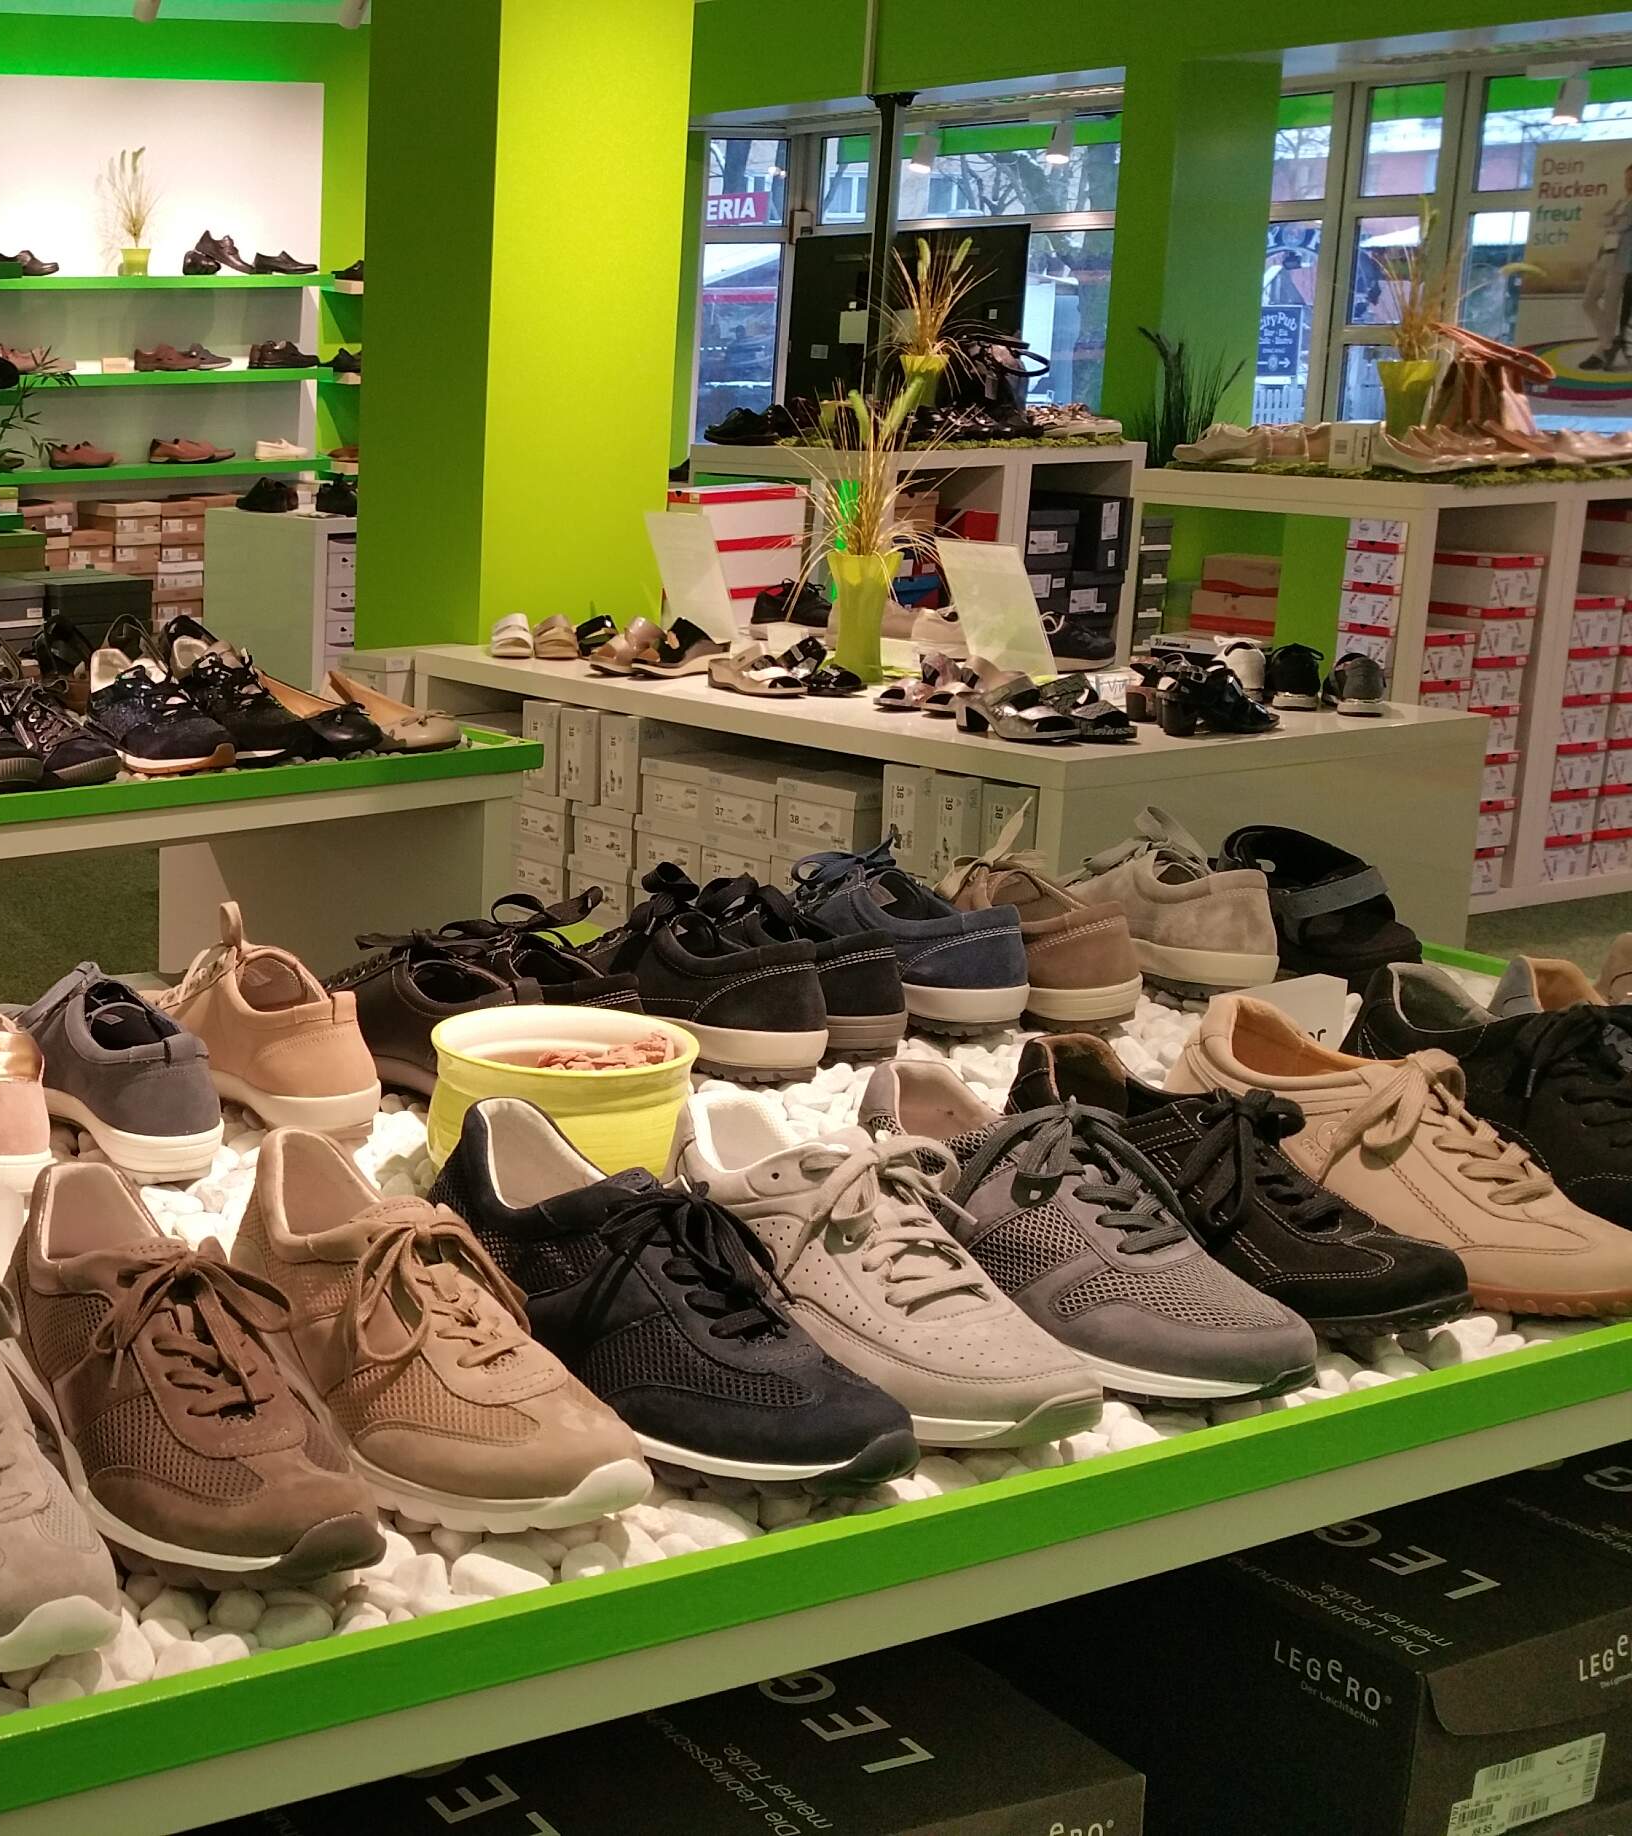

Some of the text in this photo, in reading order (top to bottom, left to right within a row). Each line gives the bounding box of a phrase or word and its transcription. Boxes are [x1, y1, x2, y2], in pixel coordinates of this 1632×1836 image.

[1541, 157, 1585, 176] Dein
[1537, 180, 1608, 199] Rücken
[706, 197, 756, 221] ERIA
[1535, 204, 1582, 222] freut
[1533, 228, 1569, 246] sich
